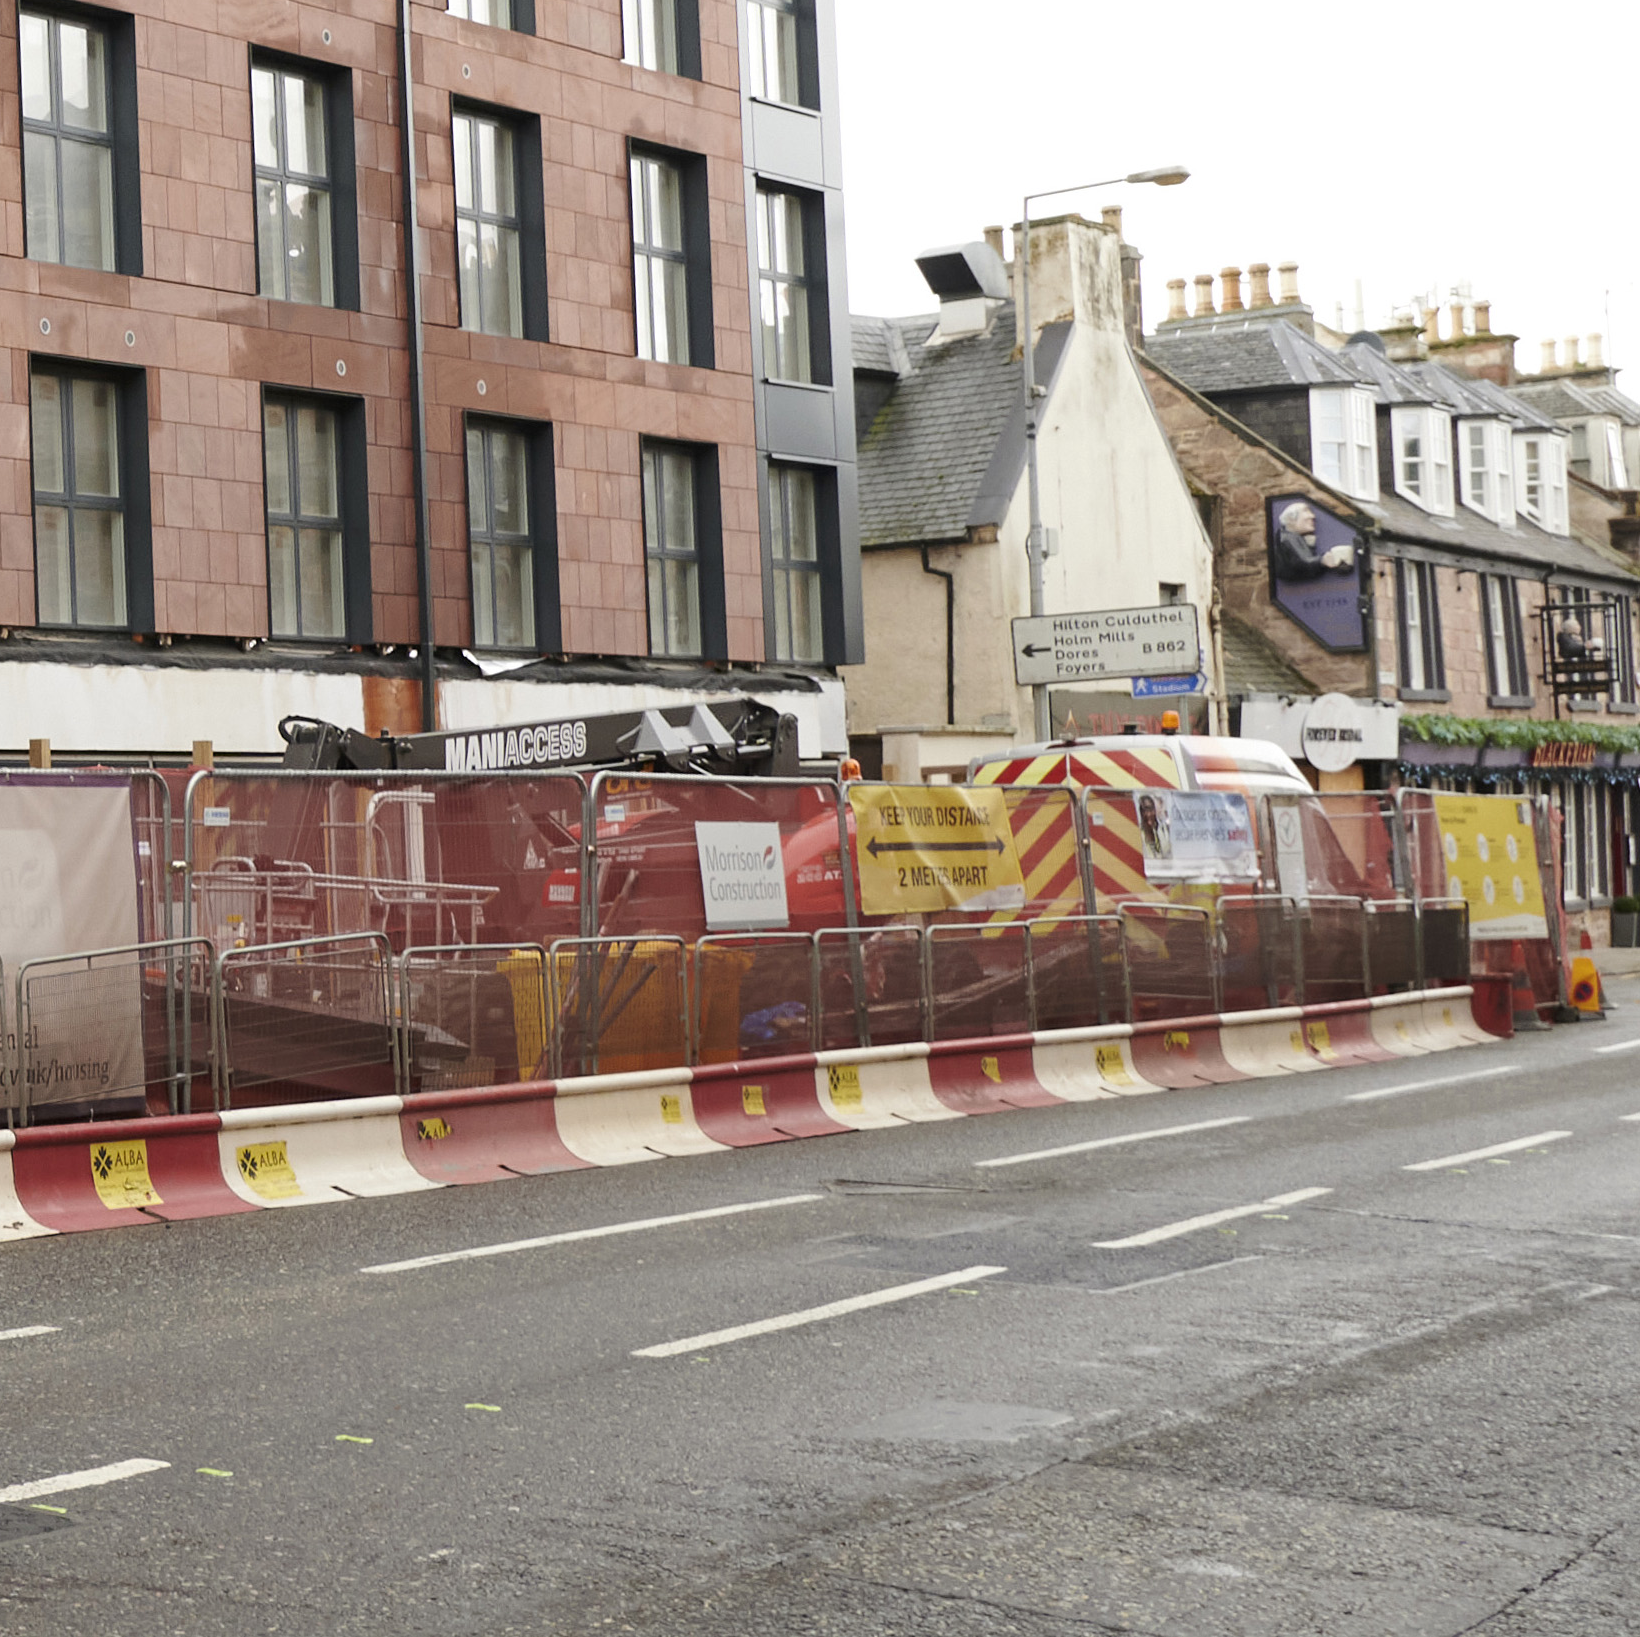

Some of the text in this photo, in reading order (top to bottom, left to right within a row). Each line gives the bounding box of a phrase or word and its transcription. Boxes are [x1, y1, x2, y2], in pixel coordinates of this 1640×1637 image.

[1053, 611, 1184, 632] Hilton Culduthel
[1054, 631, 1135, 647] Holm Mills
[1142, 640, 1186, 654] B 862
[1055, 649, 1099, 661] Dores
[1056, 663, 1106, 676] Foyers
[445, 721, 587, 771] MANIACCESS
[906, 806, 934, 827] YOUR
[705, 844, 763, 873] Morrison
[898, 867, 908, 887] 2
[952, 866, 988, 886] APART
[710, 875, 782, 902] Construction
[115, 1150, 145, 1168] ALBA
[259, 1150, 287, 1168] ALBA
